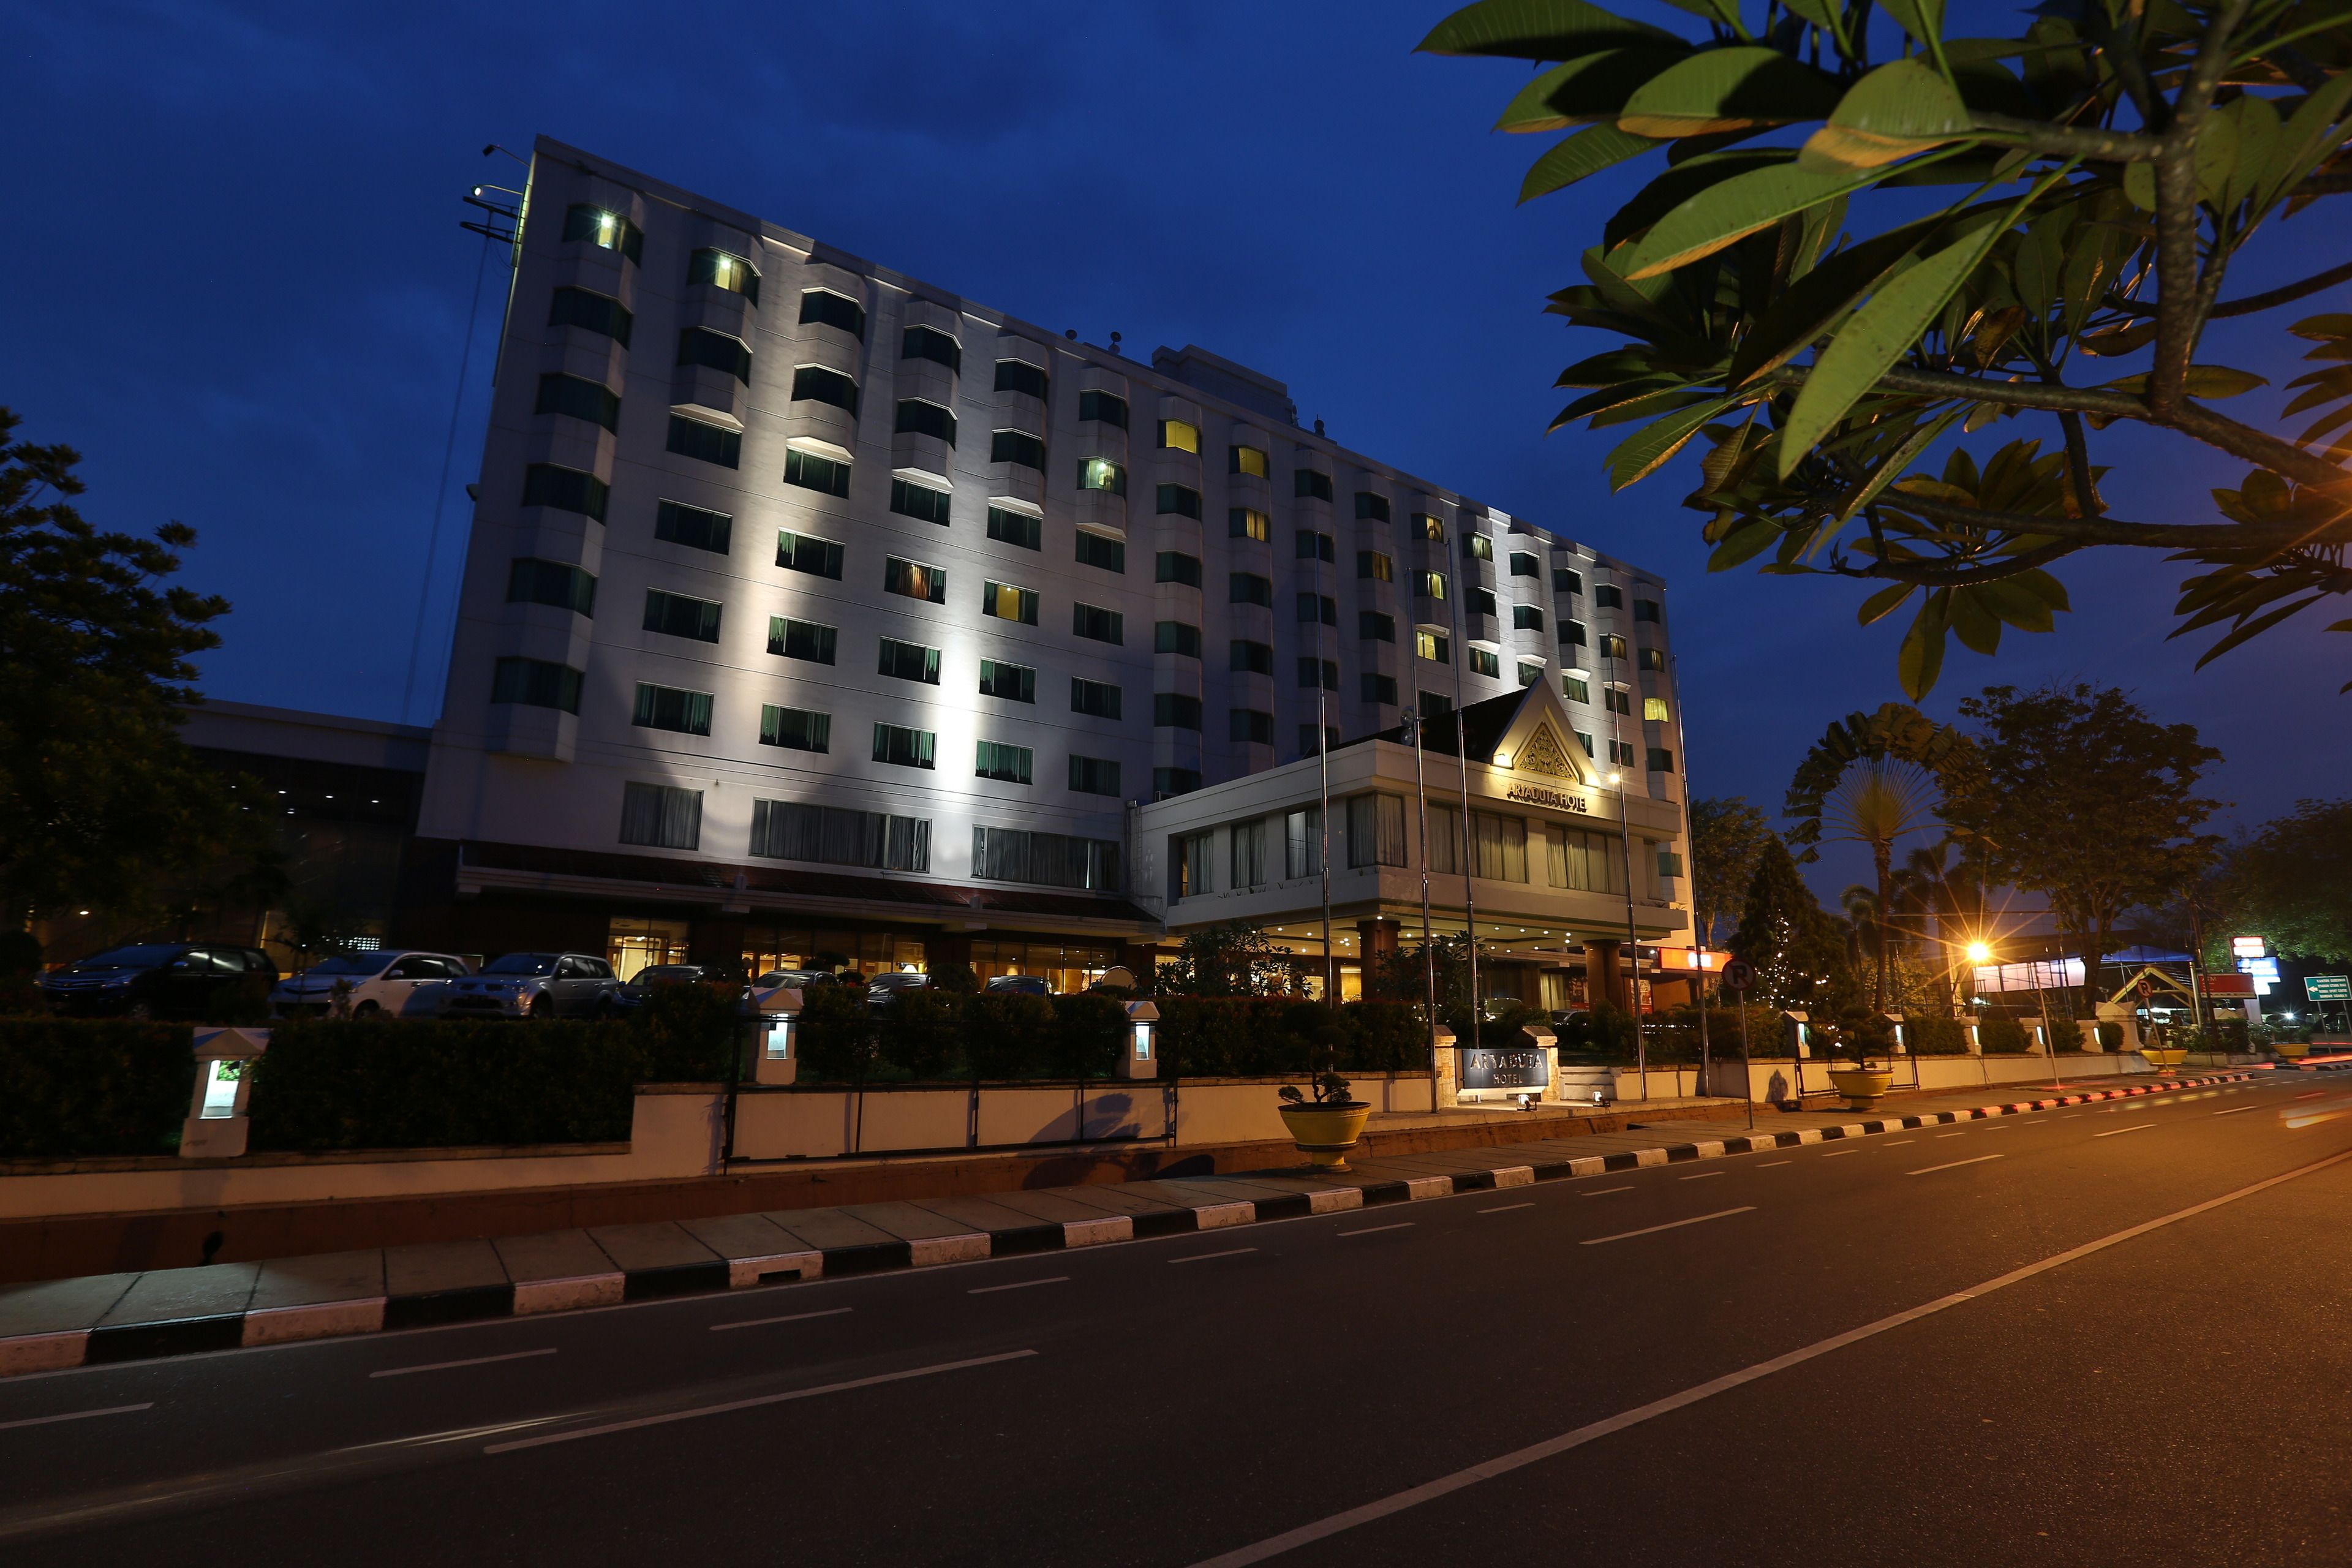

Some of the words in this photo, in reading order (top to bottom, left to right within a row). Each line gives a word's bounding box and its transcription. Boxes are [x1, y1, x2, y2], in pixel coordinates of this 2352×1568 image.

[1507, 782, 1556, 804] ARYADUTA
[1470, 1053, 1543, 1069] ARYADUTA
[1493, 1074, 1523, 1084] HOTEL
